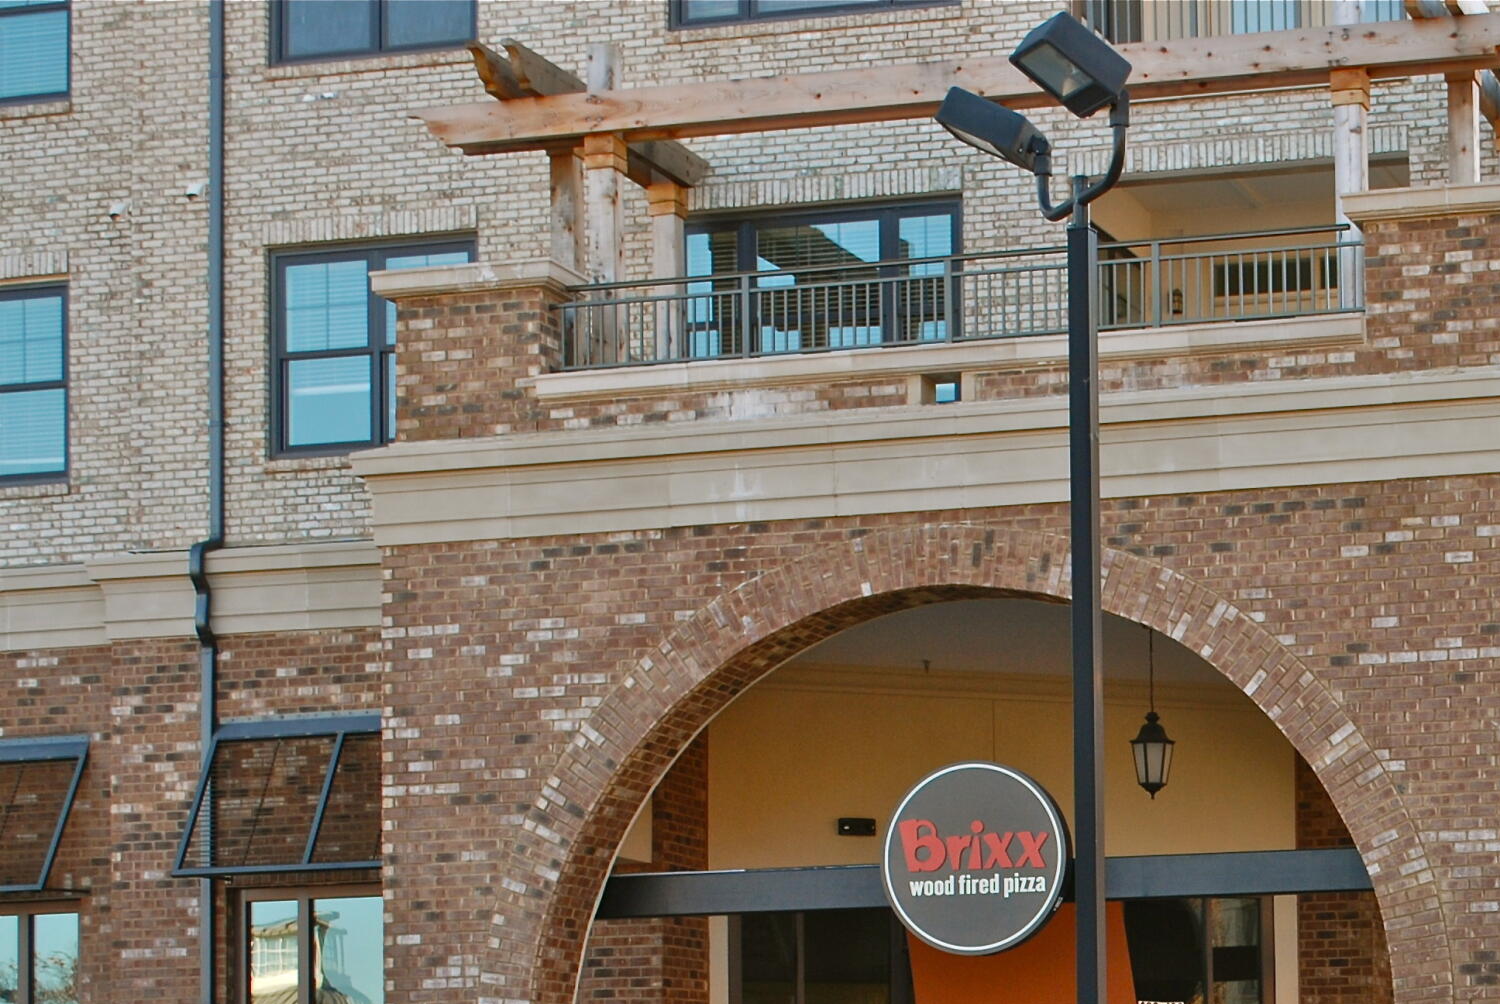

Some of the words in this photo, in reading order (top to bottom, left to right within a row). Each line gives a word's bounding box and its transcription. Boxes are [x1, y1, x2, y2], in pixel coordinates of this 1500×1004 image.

[898, 818, 1050, 872] Brixx
[910, 875, 954, 896] wood
[958, 873, 999, 895] fired
[1004, 872, 1046, 898] pizza
